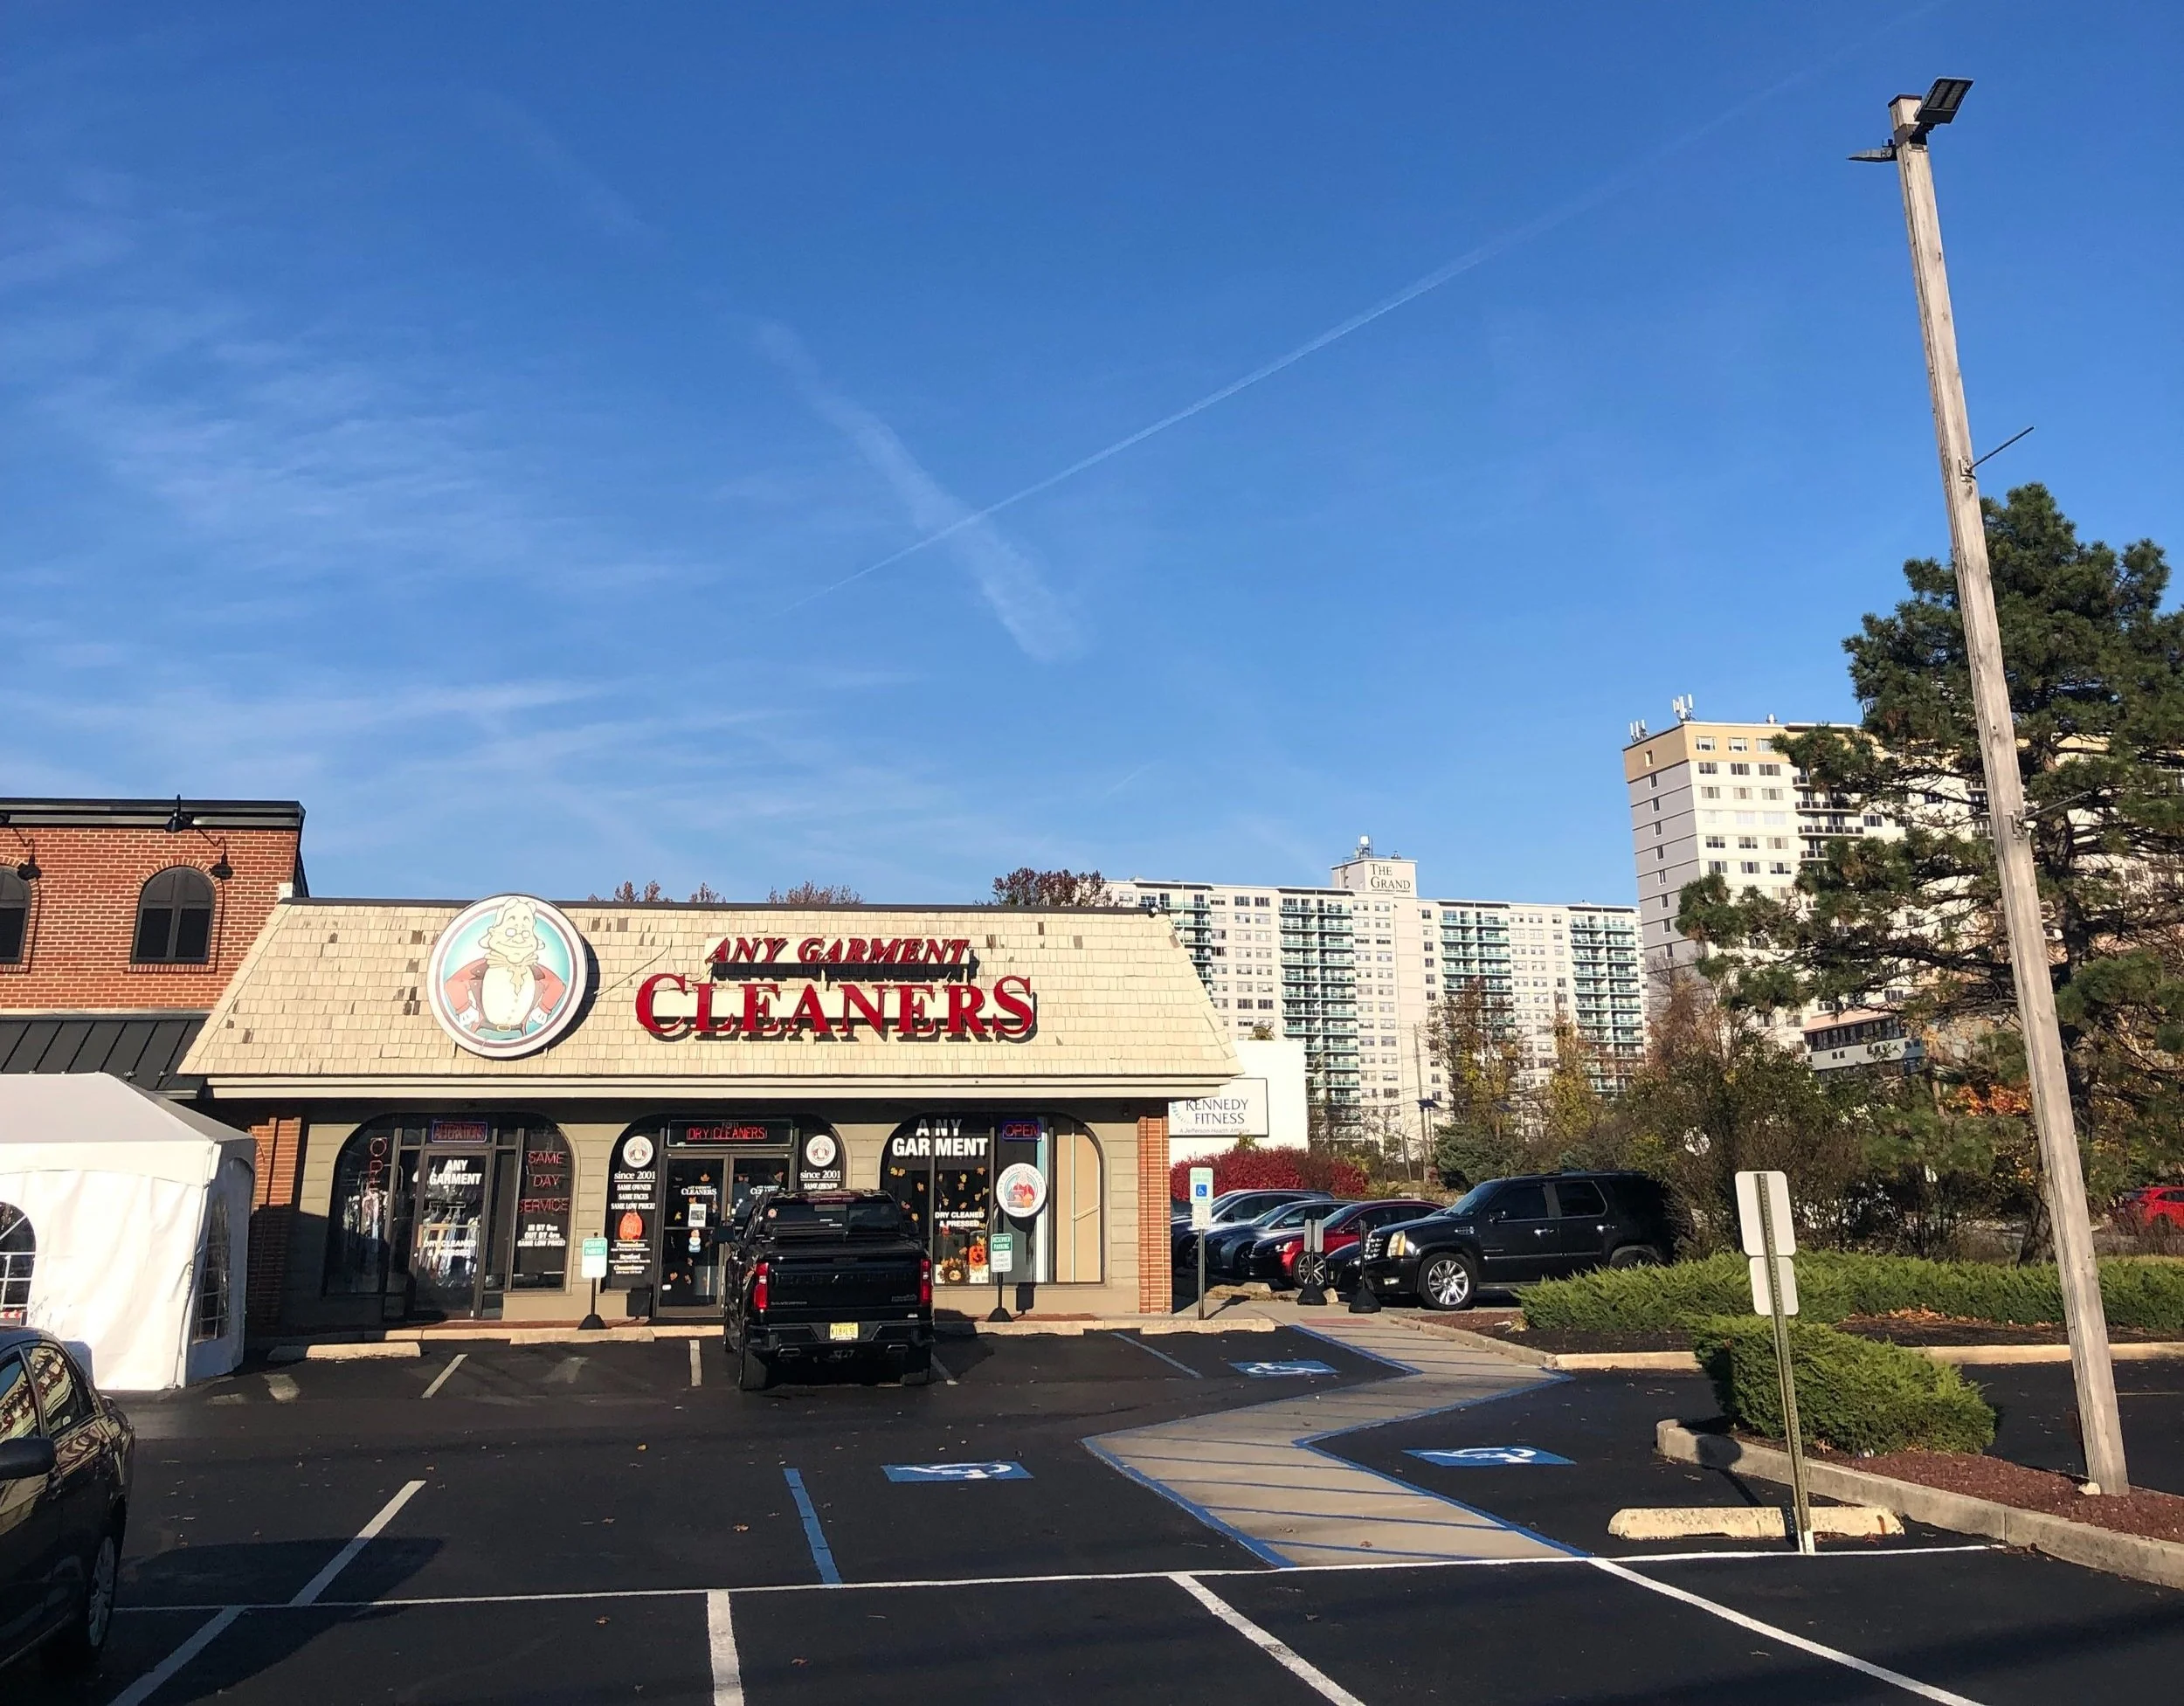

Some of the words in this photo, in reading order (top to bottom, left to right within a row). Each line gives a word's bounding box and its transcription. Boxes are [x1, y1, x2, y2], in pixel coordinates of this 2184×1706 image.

[1370, 863, 1393, 875] THE
[1371, 876, 1410, 888] GRAND
[705, 937, 788, 964] ANY
[796, 937, 970, 964] GARMENT
[635, 973, 1034, 1035] CLEANERS
[1185, 1099, 1249, 1112] KENNEDY
[1194, 1112, 1245, 1125] FITNESS
[688, 1127, 709, 1140] DRY
[712, 1126, 766, 1140] CLEANERS
[916, 1118, 962, 1136] ANY
[1004, 1124, 1040, 1137] OPEN
[892, 1137, 989, 1157] GARMENT
[528, 1152, 564, 1164] SAME
[442, 1159, 468, 1171] ANY
[428, 1173, 482, 1185] GARMENT
[533, 1174, 559, 1187] DAY
[614, 1171, 635, 1179] since
[637, 1171, 656, 1180] 2001
[800, 1170, 820, 1179] since
[822, 1170, 841, 1179] 2001
[519, 1198, 569, 1214] SERVICE
[948, 1219, 980, 1228] PRESSED
[440, 1239, 477, 1247] CLEANED
[435, 1248, 471, 1257] PRESSED
